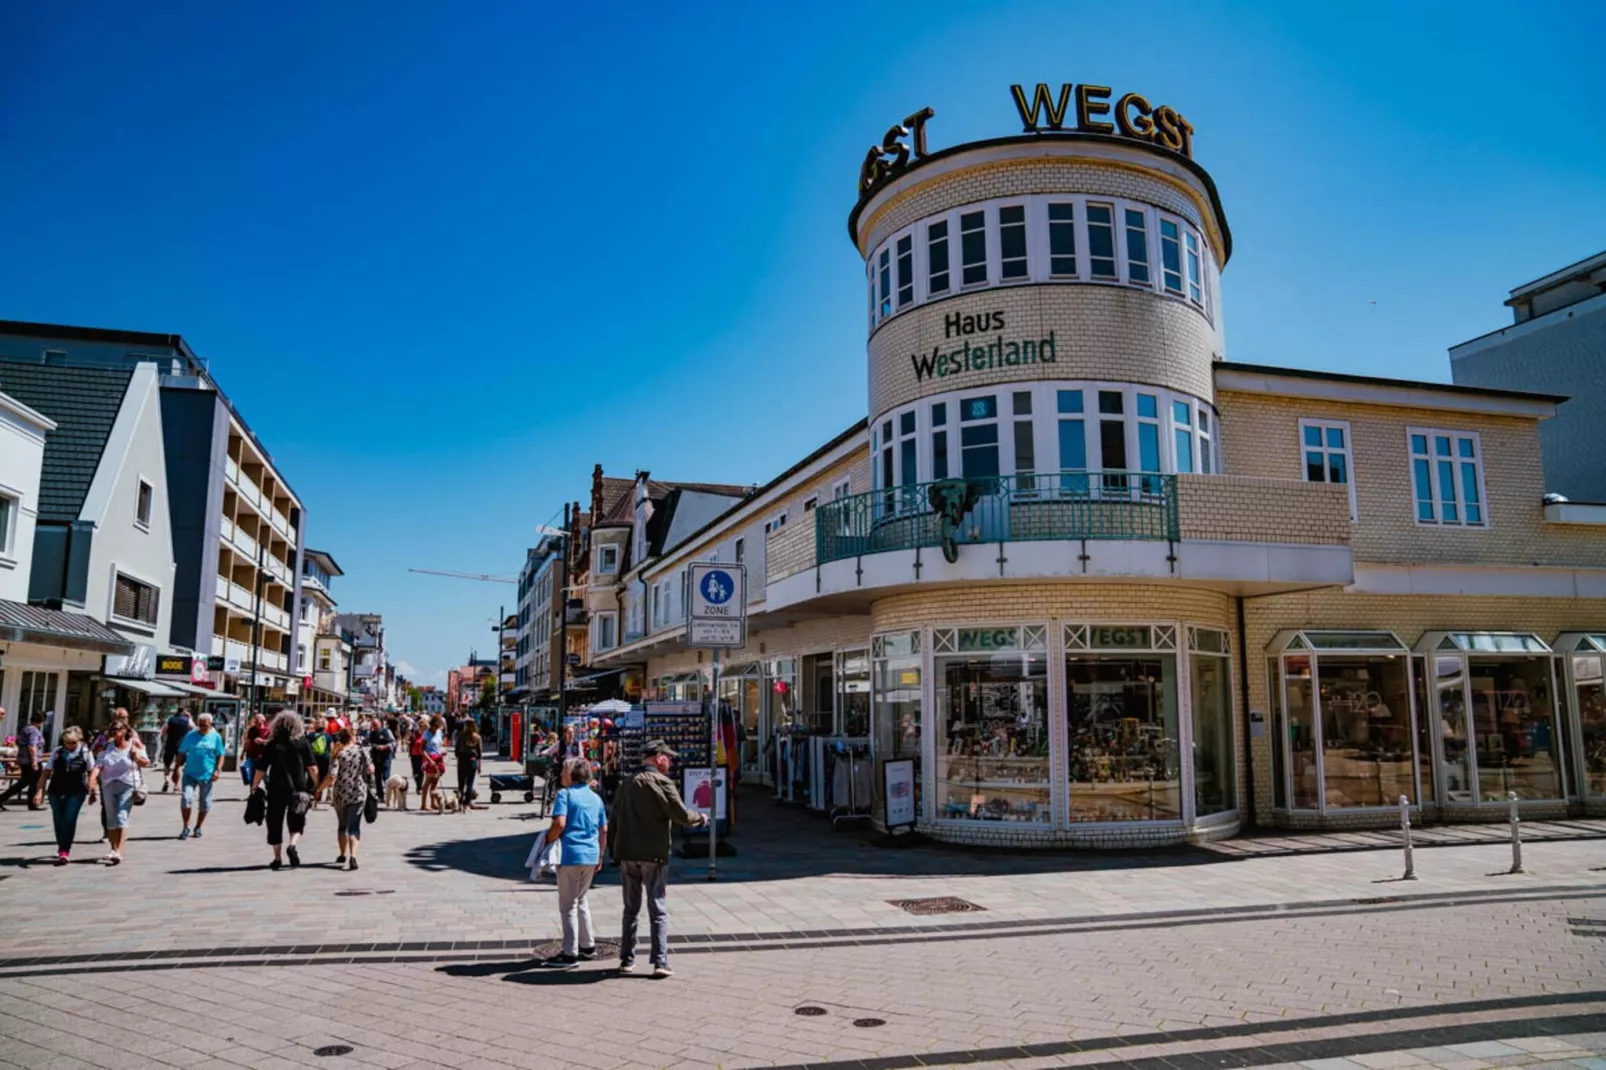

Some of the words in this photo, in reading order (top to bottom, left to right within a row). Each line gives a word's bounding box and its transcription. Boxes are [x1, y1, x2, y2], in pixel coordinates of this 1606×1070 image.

[1010, 83, 1194, 158] WEGST
[944, 310, 1005, 338] Haus
[911, 331, 1056, 382] Westerland
[703, 606, 729, 616] ZONE
